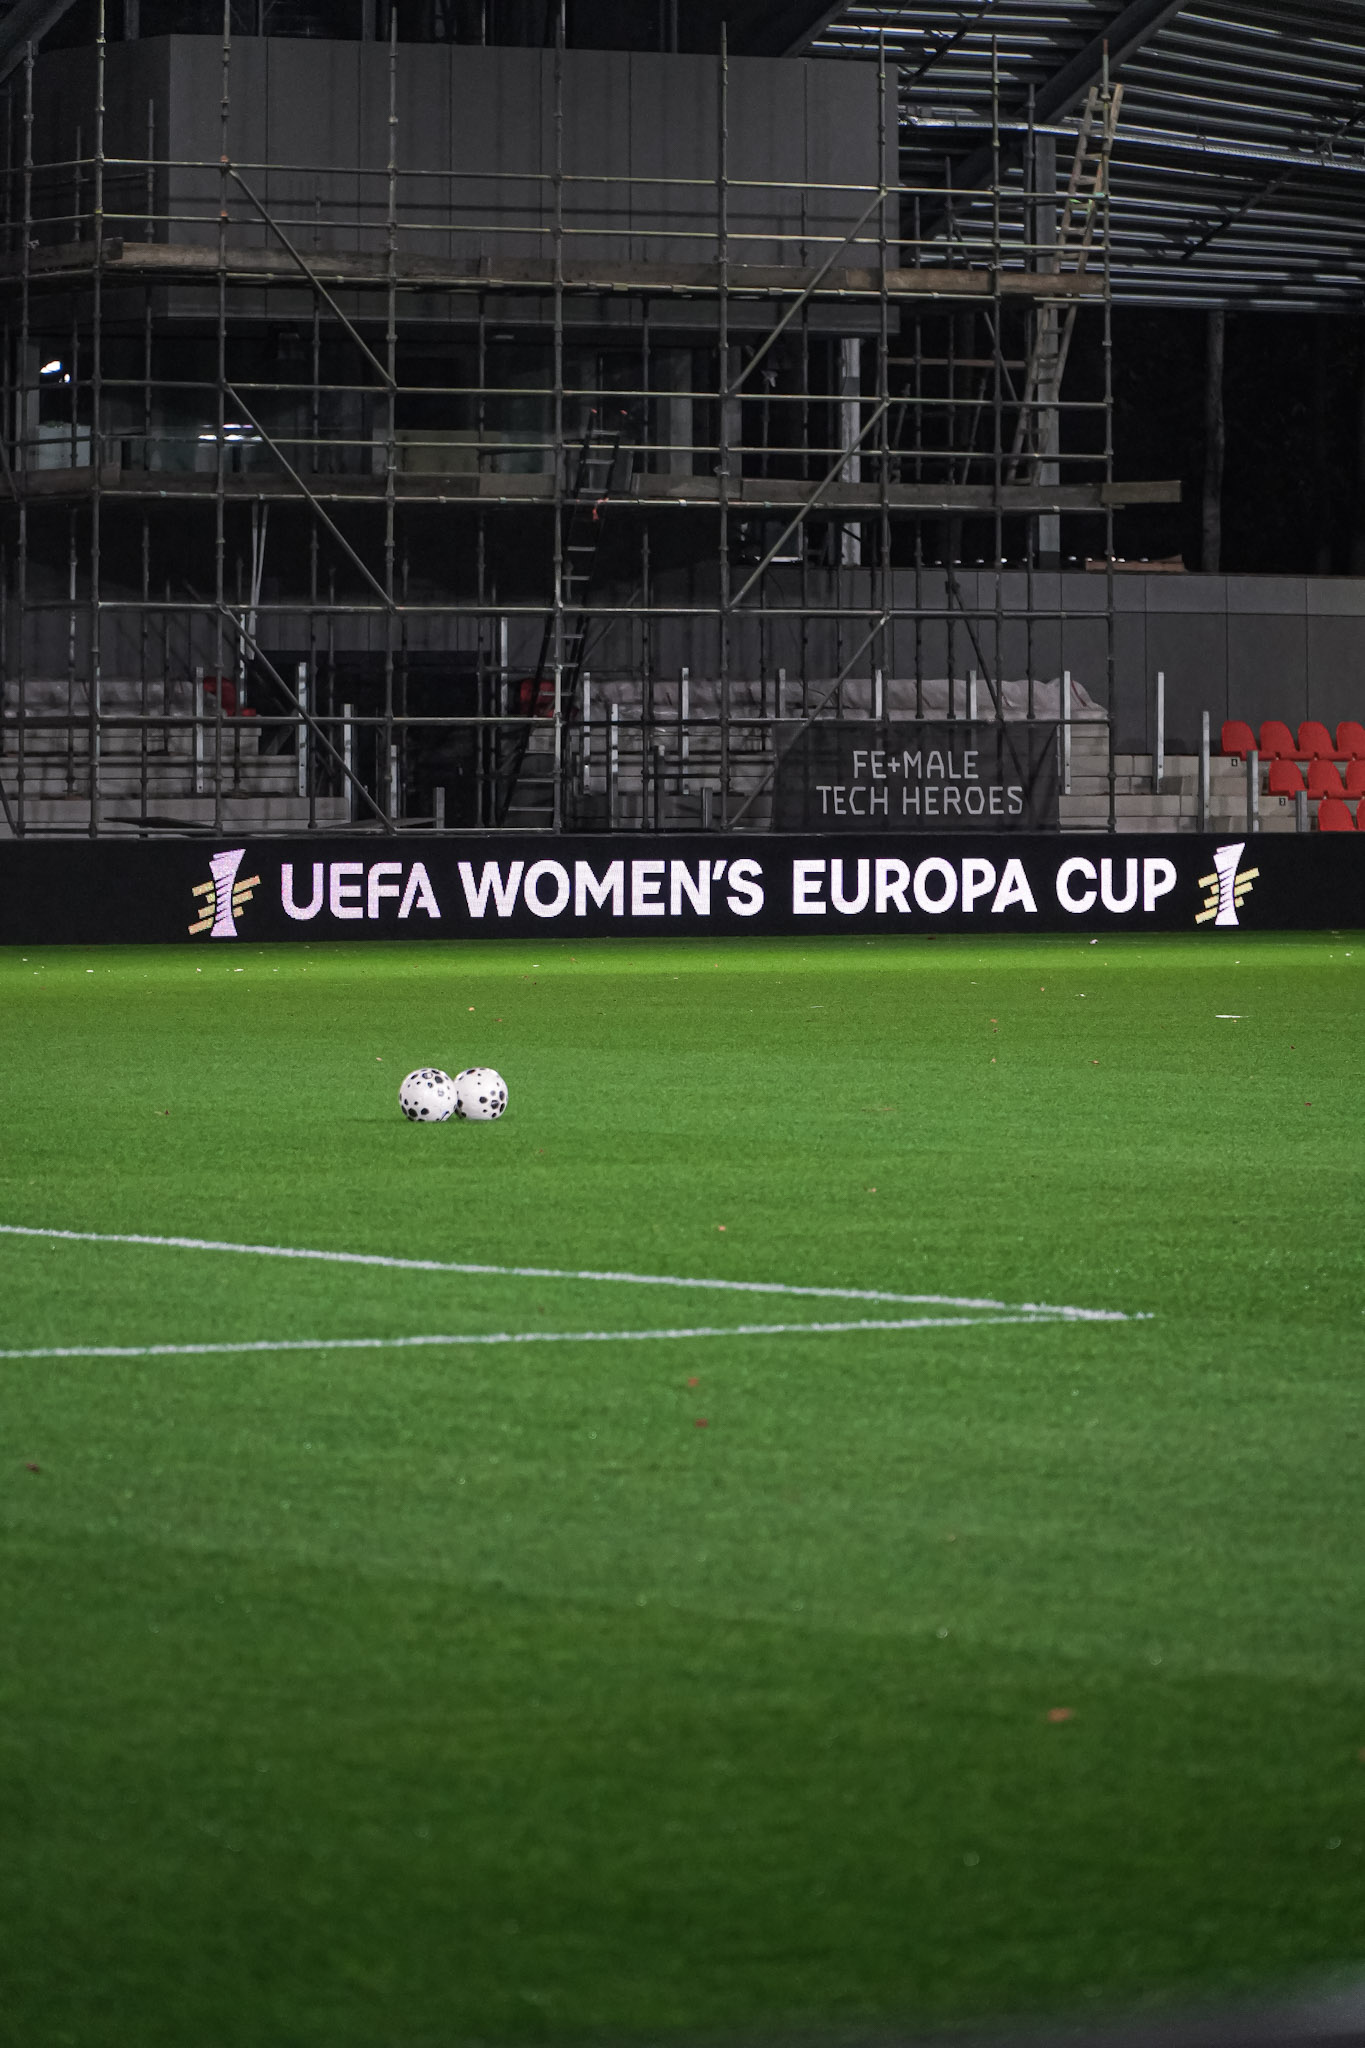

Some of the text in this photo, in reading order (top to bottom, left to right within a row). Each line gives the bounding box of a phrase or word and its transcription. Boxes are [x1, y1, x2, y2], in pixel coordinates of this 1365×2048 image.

[853, 751, 979, 779] FE+MALE
[816, 786, 1023, 815] TECH HEROES
[282, 857, 1178, 920] UEFA WOMEN'S EUROPA CUP
